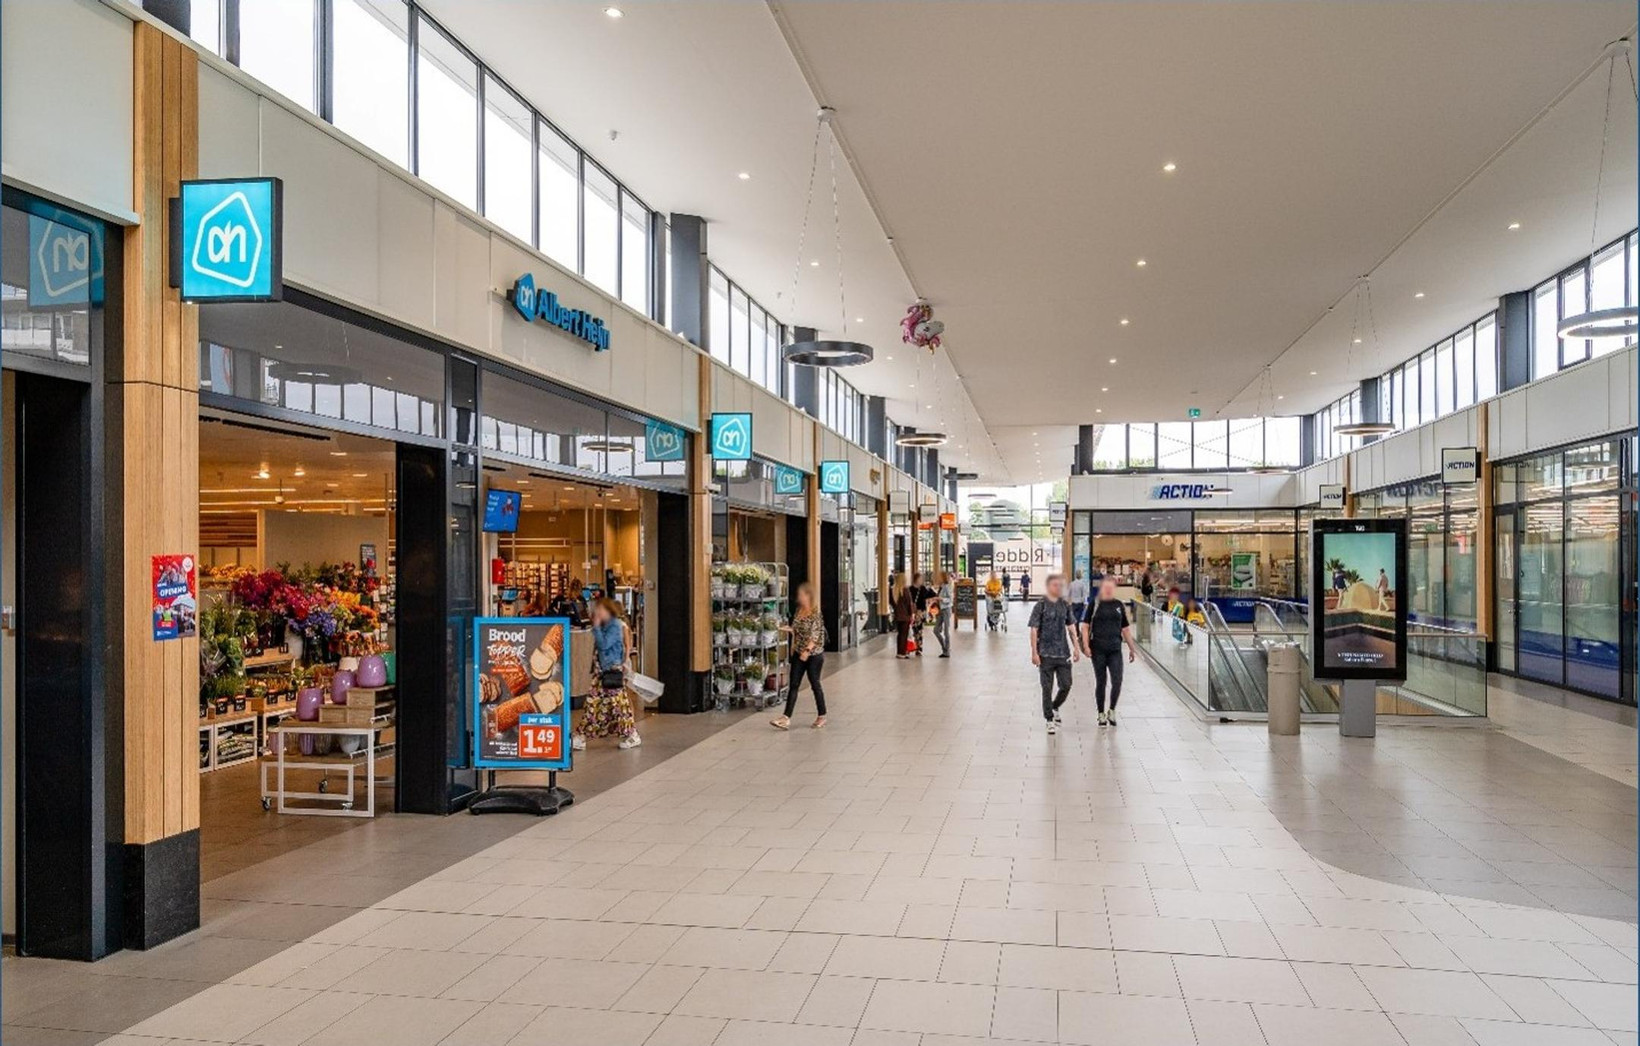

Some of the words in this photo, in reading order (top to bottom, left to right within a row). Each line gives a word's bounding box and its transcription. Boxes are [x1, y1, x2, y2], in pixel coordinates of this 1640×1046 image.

[536, 288, 582, 337] Albert
[582, 311, 610, 352] Heijn
[489, 628, 526, 643] Brood
